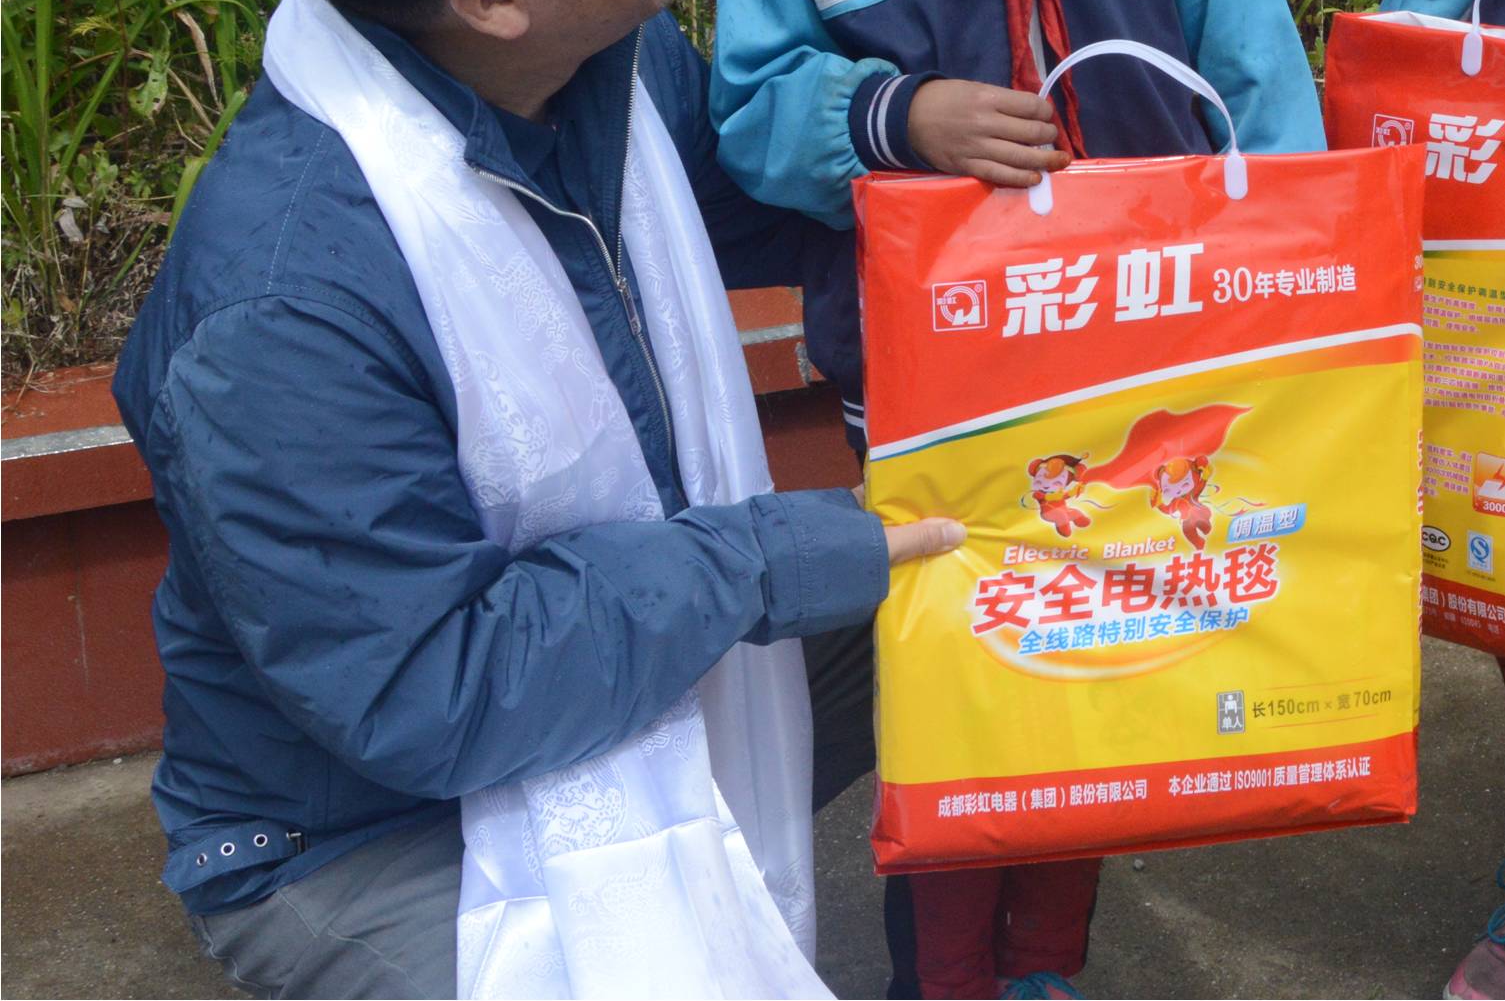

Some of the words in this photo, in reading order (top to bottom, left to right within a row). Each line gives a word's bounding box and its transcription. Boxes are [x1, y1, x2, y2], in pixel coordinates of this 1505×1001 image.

[1002, 243, 1204, 338] 彩虹
[1213, 264, 1357, 304] 30年专业制造
[1233, 508, 1300, 540] 调温型
[1003, 545, 1089, 565] Electric
[1103, 536, 1175, 560] Blanket
[972, 543, 1279, 635] 安全电热毯
[1019, 607, 1250, 655] 全线路特别安全保护
[1222, 715, 1243, 730] 单人
